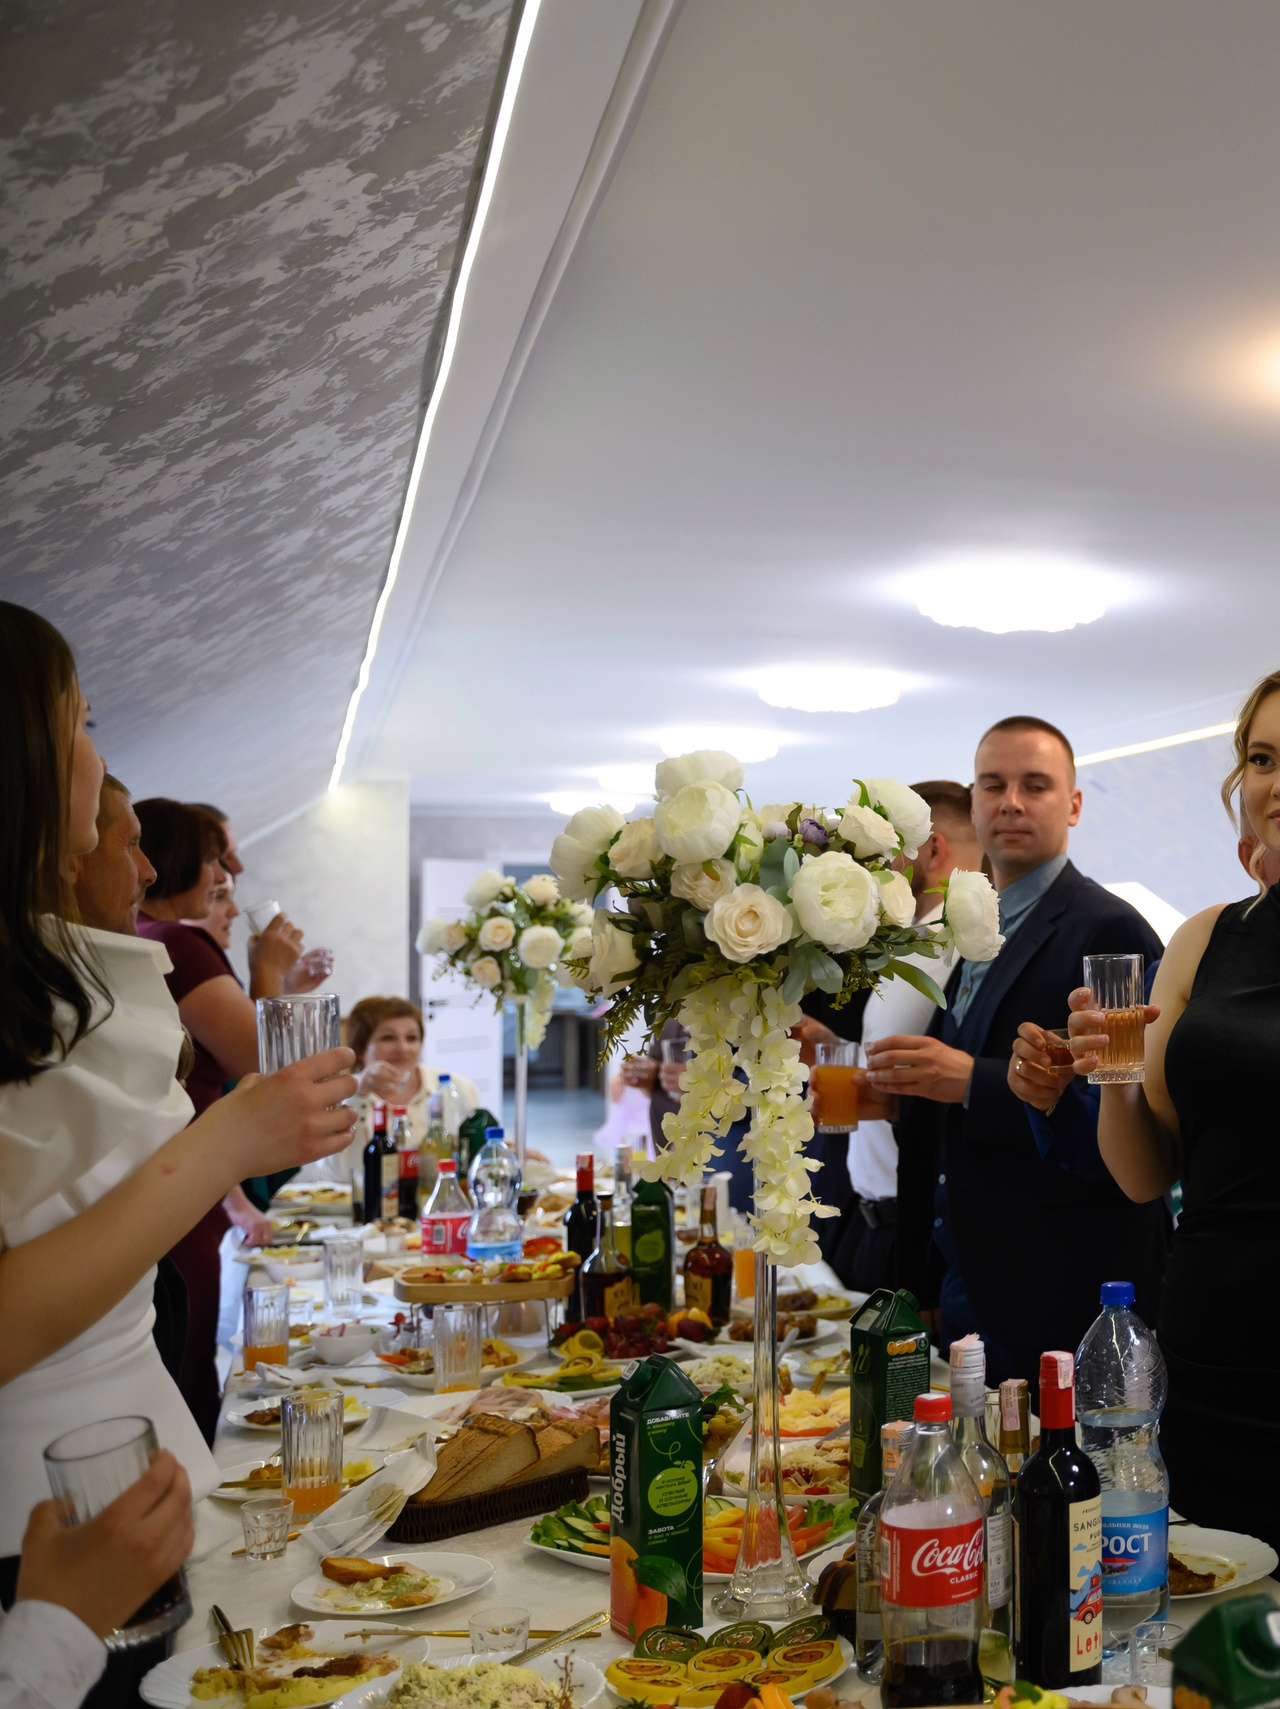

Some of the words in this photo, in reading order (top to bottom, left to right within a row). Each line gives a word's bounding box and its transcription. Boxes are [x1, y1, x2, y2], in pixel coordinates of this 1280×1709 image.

[611, 1433, 626, 1524] Добрый
[648, 1525, 675, 1535] ЗАБОТА
[949, 1570, 979, 1585] CLASSIC
[1076, 1631, 1103, 1656] Let
